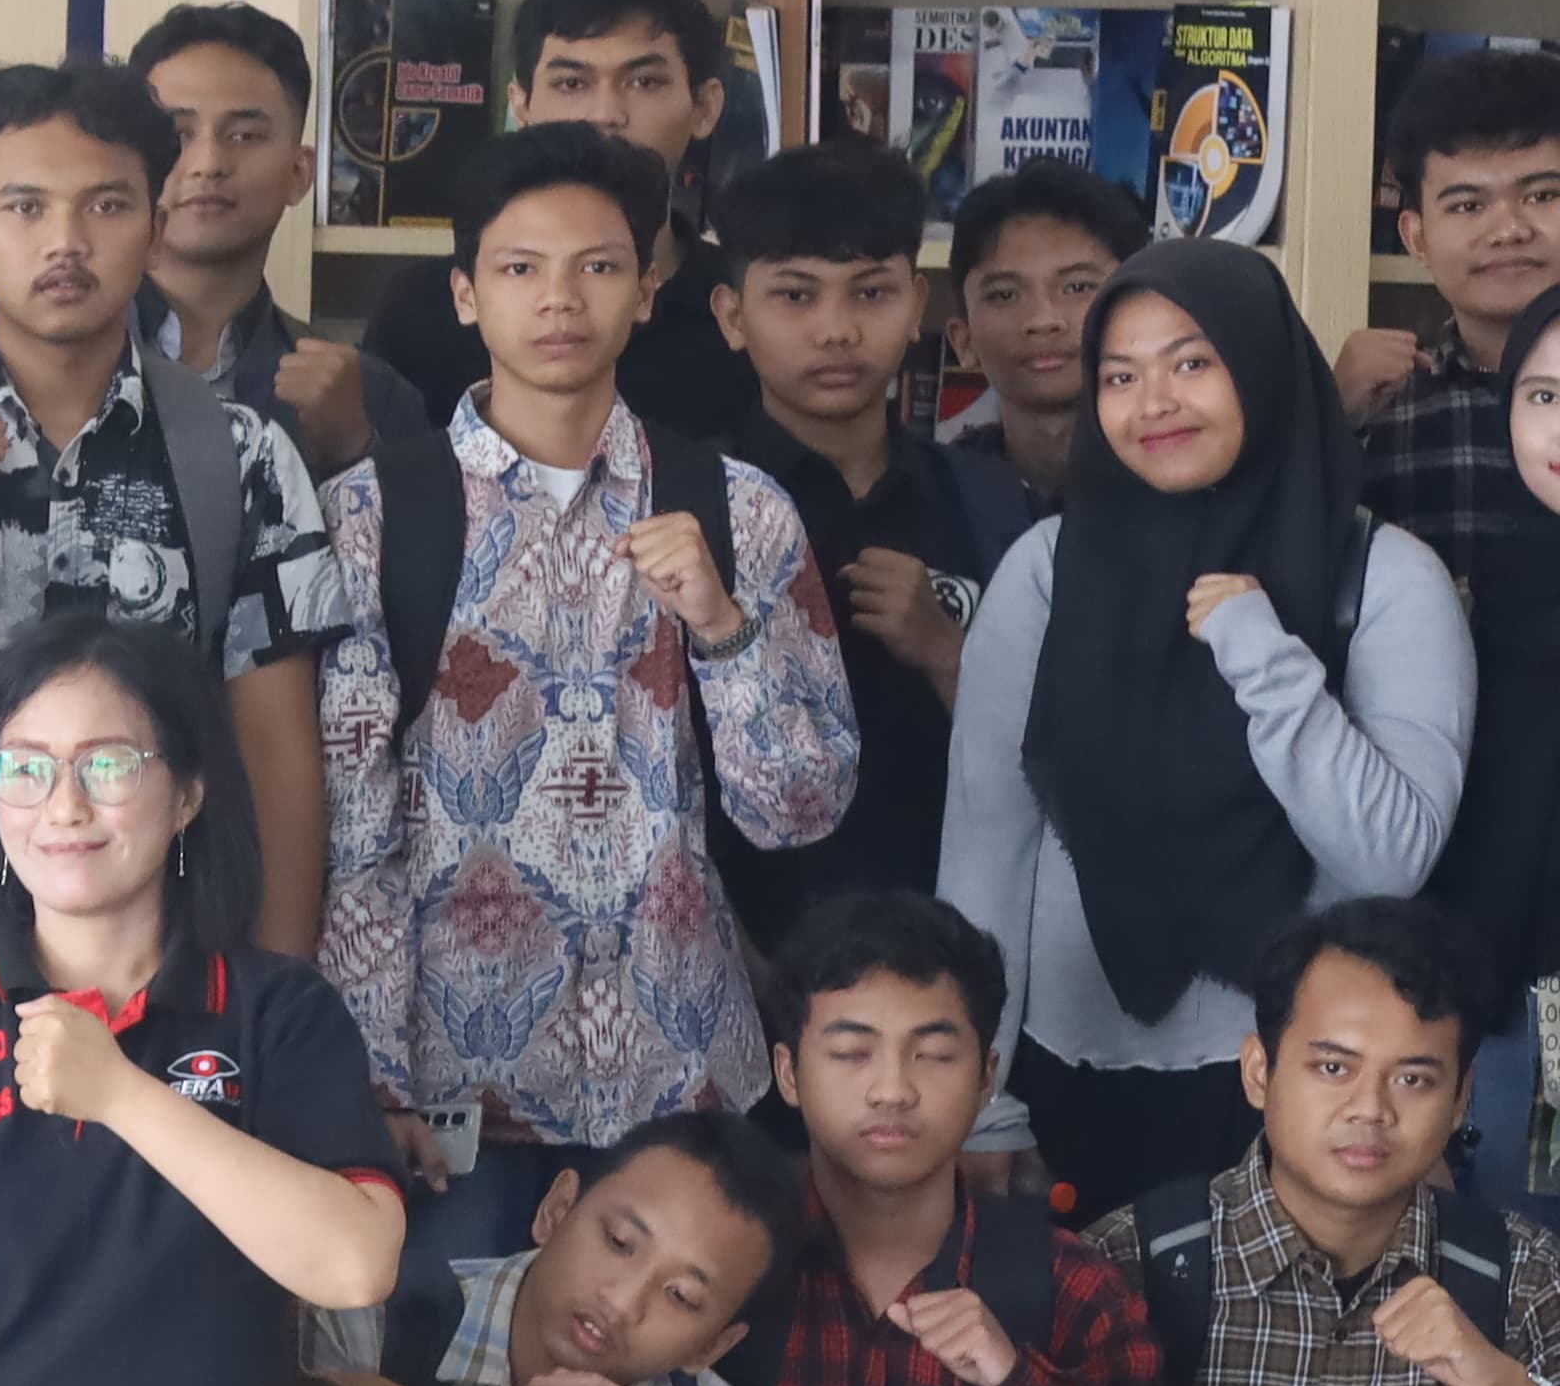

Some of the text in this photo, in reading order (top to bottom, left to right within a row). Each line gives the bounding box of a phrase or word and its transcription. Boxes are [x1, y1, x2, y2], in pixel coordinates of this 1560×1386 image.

[1175, 24, 1254, 51] STRUKTUR DATA
[1186, 49, 1248, 68] ALGORITMA
